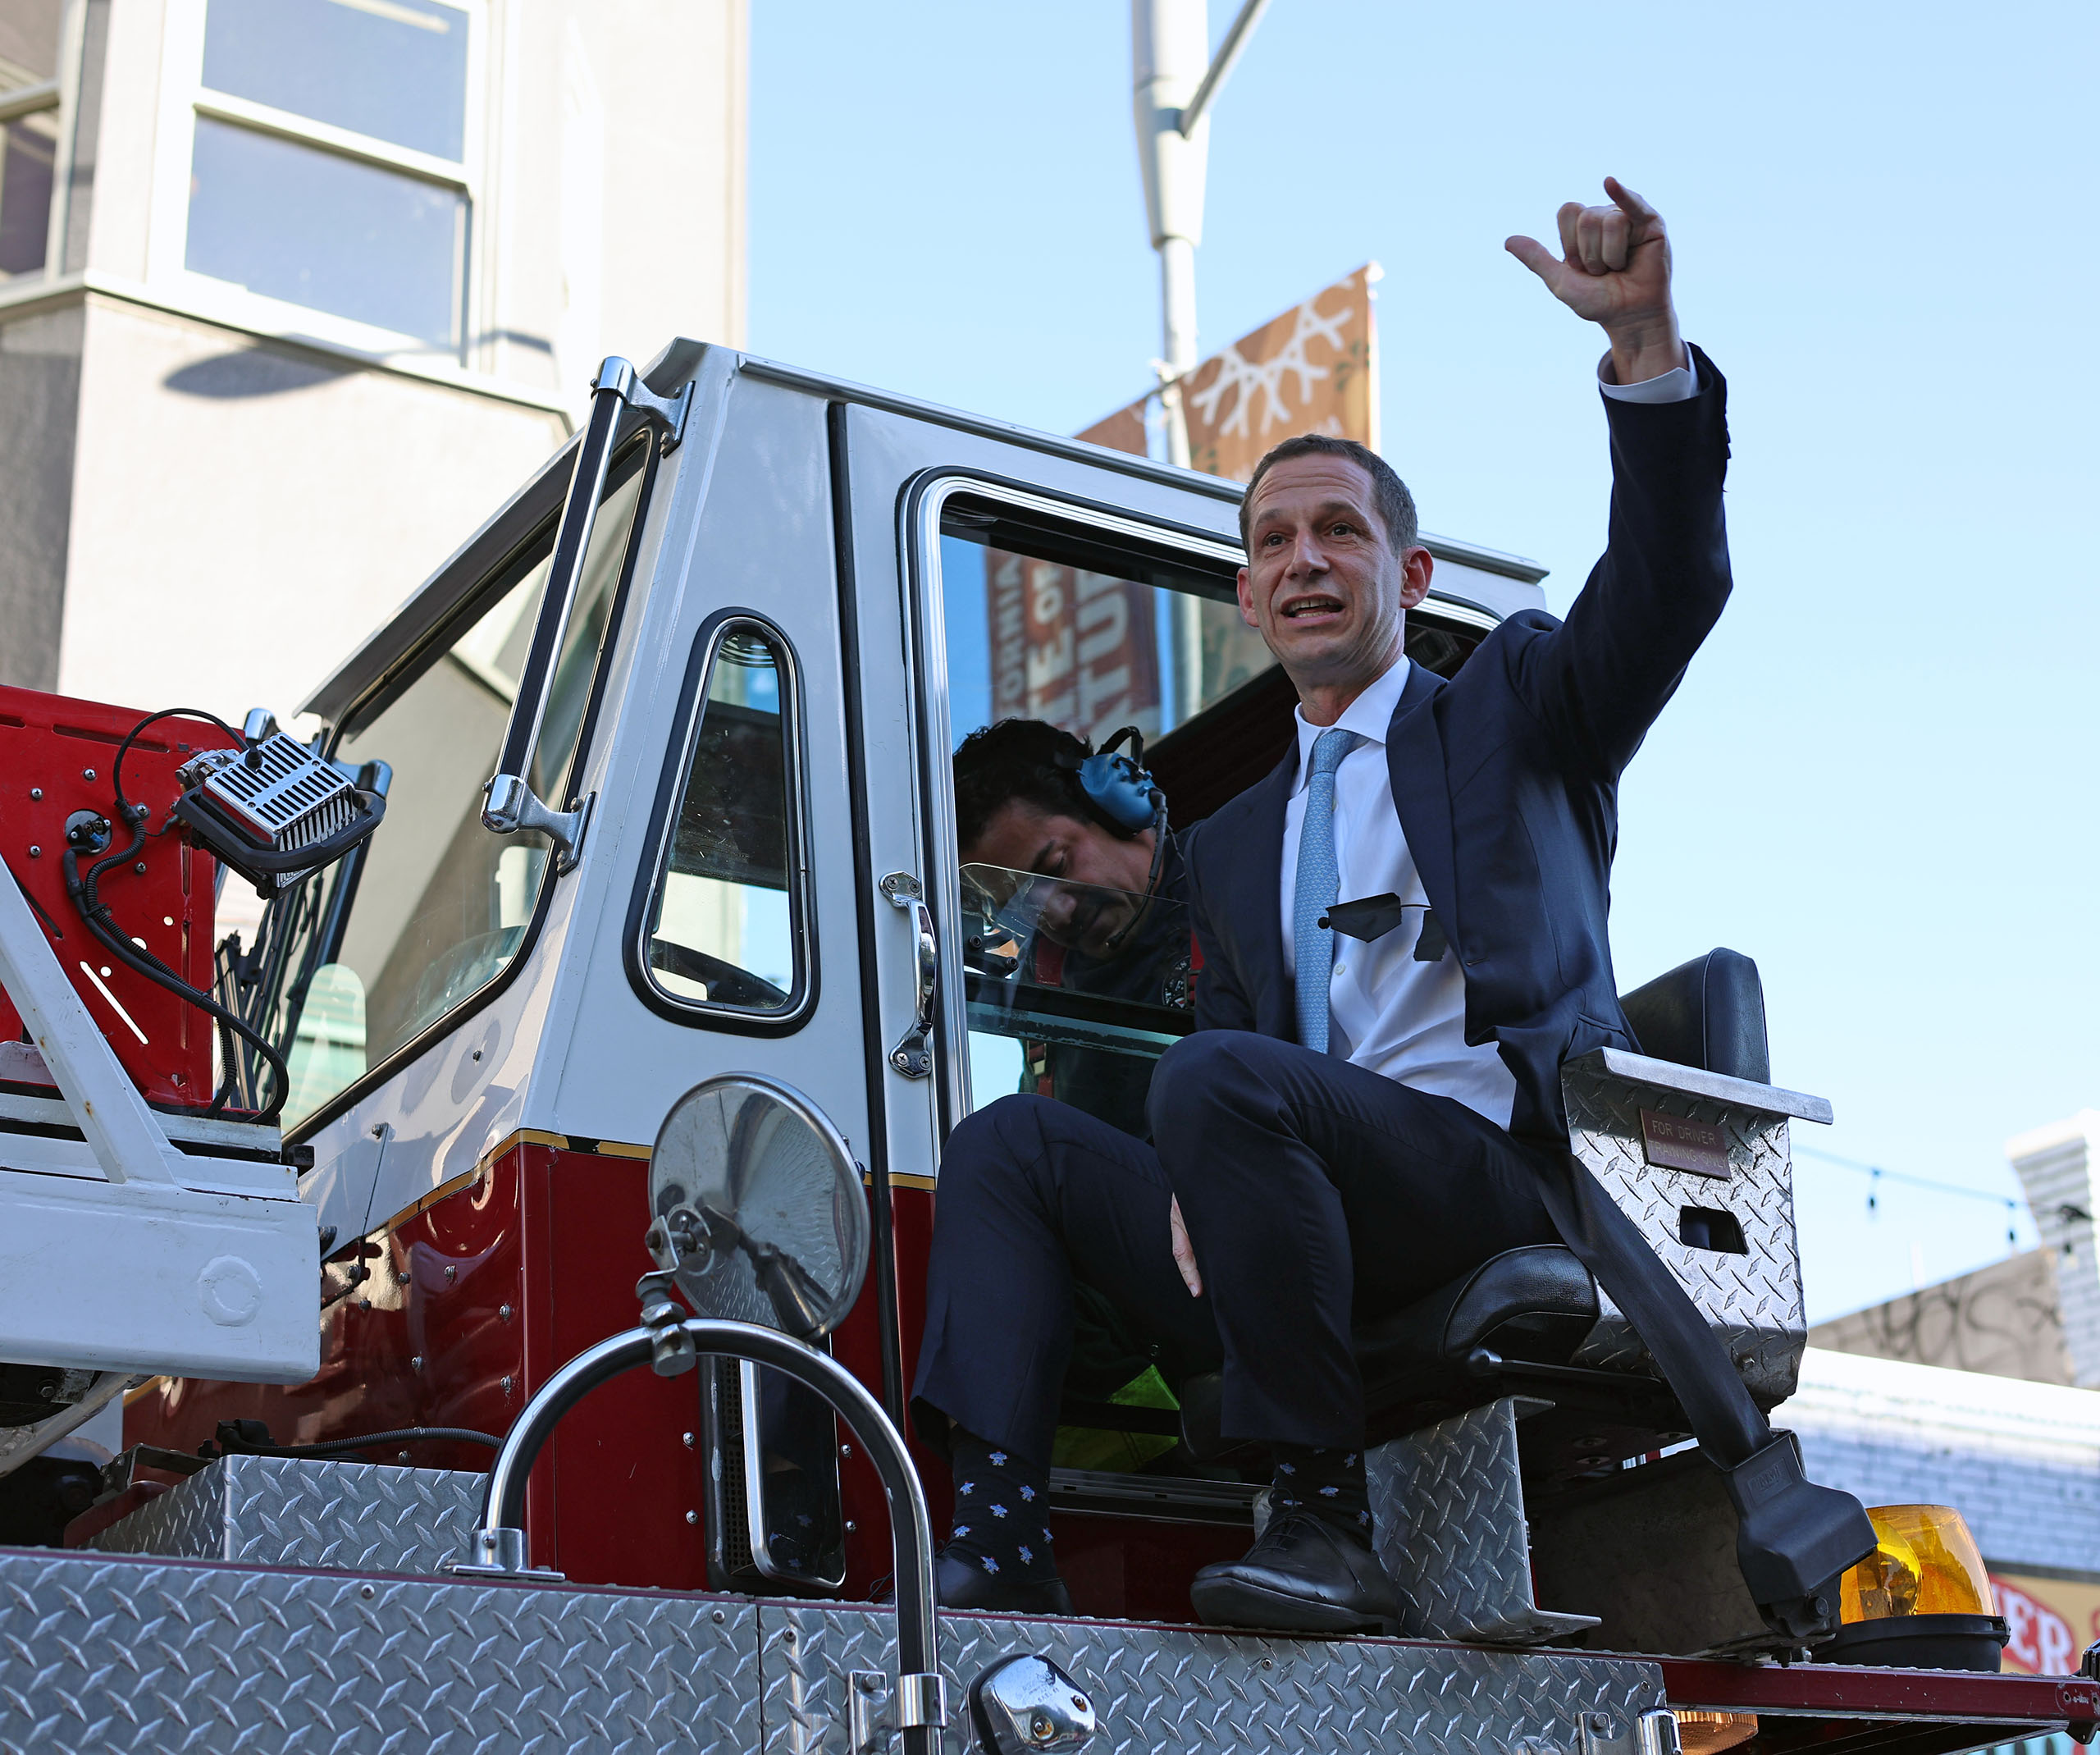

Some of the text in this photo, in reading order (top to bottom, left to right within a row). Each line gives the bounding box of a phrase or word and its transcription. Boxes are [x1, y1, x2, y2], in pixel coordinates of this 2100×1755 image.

[1031, 561, 1065, 625] OF
[1647, 1140, 1697, 1162] TRAINING
[1651, 1119, 1717, 1145] FOR DRIVER
[1992, 1584, 2073, 1675] ER
